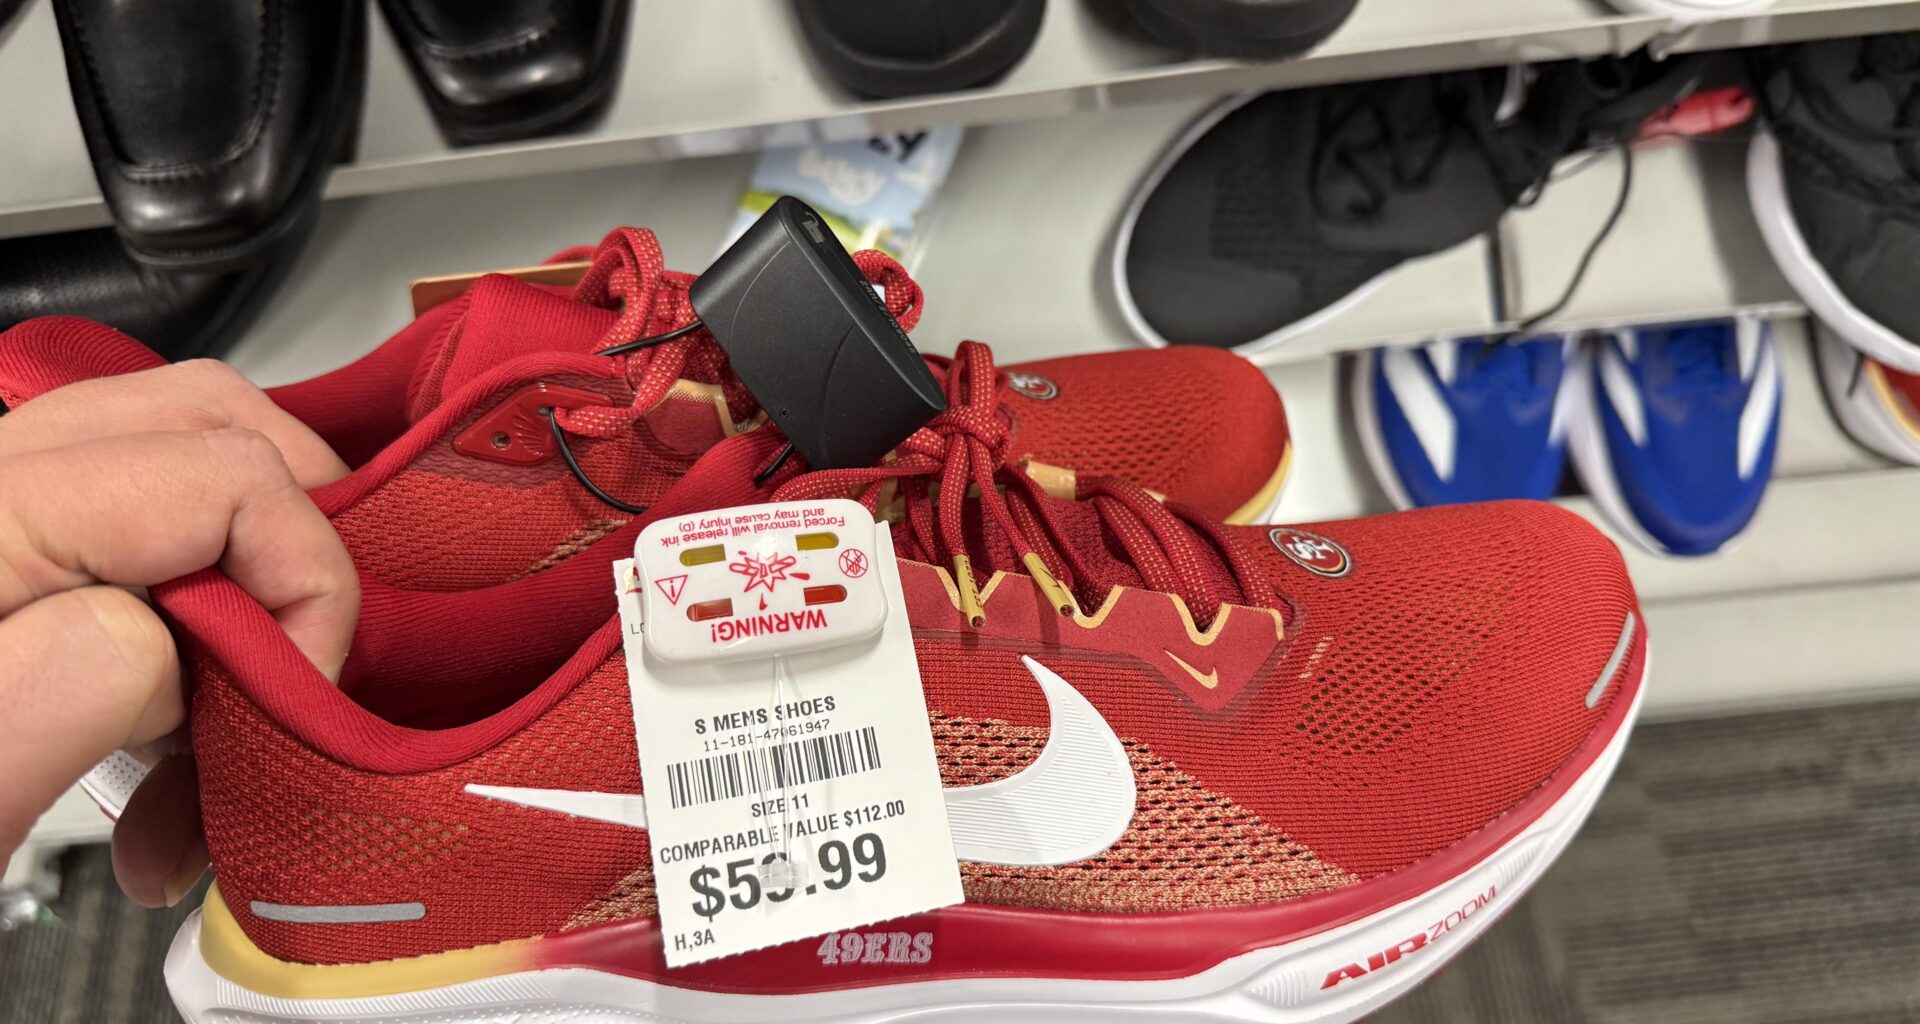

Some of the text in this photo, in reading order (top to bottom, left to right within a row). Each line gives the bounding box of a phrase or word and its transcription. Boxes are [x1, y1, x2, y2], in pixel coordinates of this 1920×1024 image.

[660, 516, 845, 548] Forced removal will release ink
[679, 508, 825, 533] and may cause injury (D)
[711, 608, 828, 643] WARNING!
[694, 696, 836, 735] S MENS SHOES
[751, 793, 809, 818] SIZE 11
[660, 799, 906, 864] COMPARABLE VALUE $112.00
[674, 928, 716, 951] H,3A
[816, 931, 934, 965] 49ERS
[1319, 885, 1497, 990] AIR ZOOM
